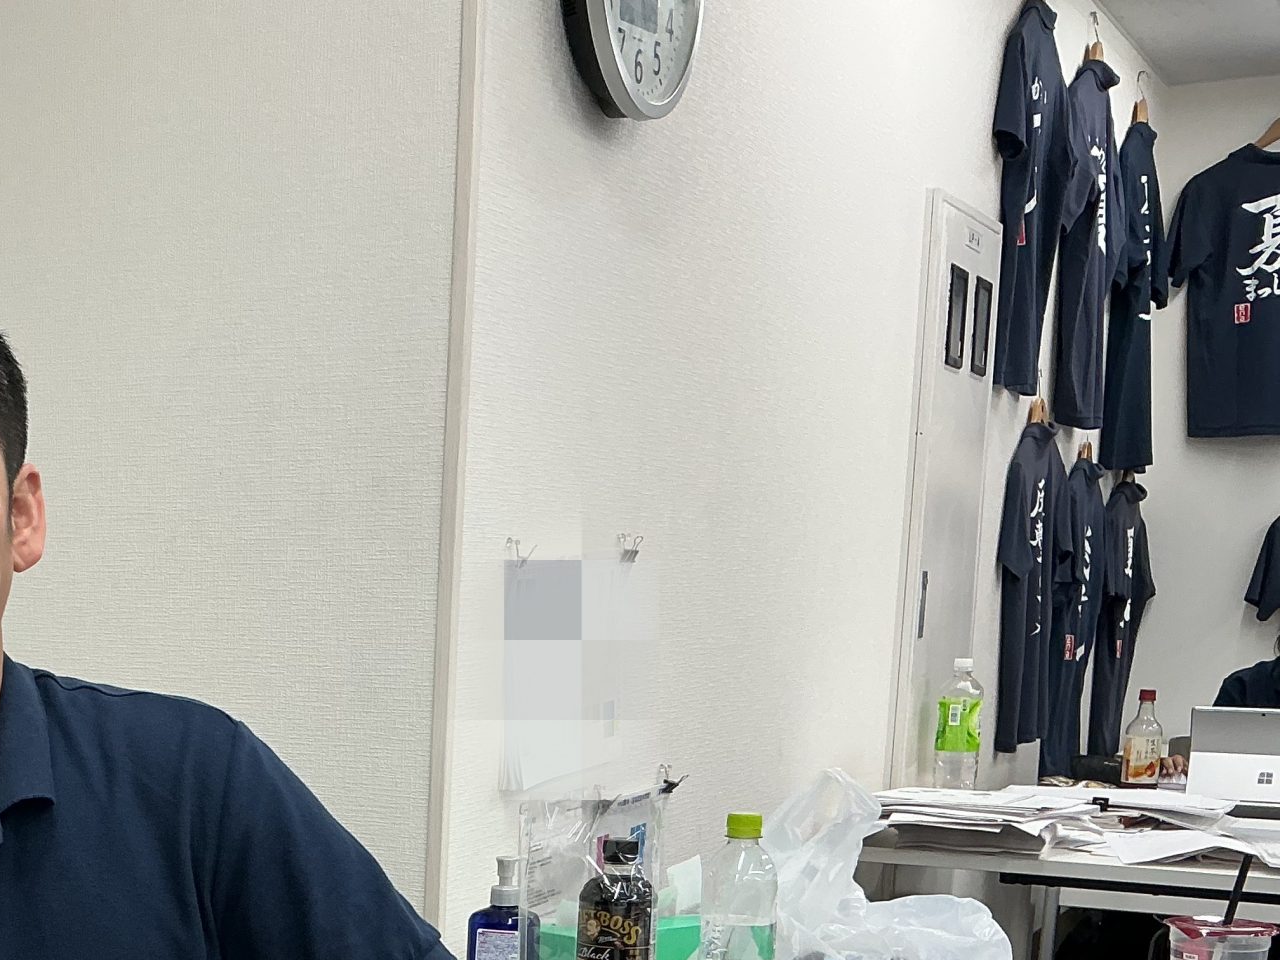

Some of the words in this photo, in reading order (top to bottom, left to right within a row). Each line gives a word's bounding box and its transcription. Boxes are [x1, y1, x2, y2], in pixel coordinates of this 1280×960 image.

[618, 26, 626, 54] 7
[666, 8, 674, 42] 4
[634, 48, 643, 84] 6
[653, 41, 661, 76] 5
[596, 910, 642, 945] BOSS
